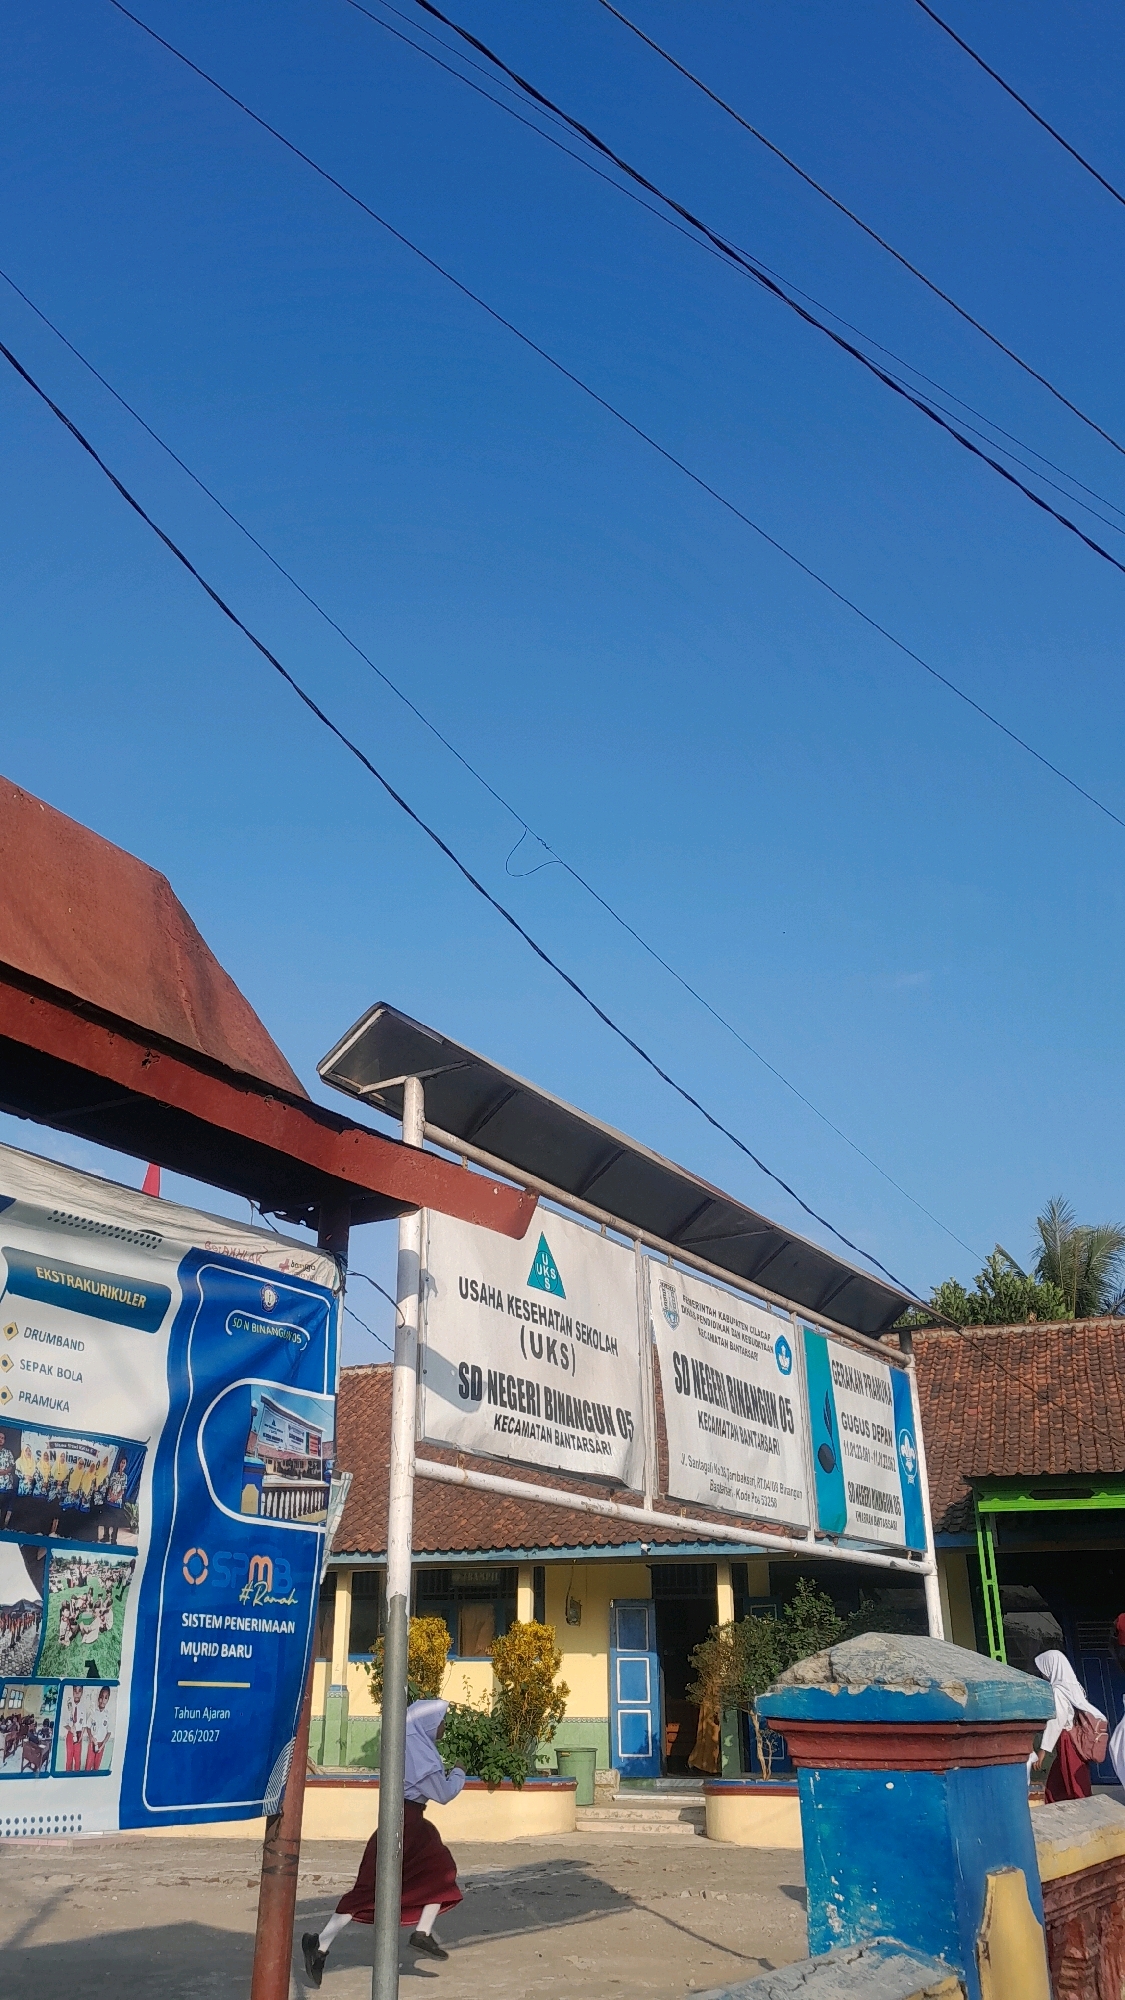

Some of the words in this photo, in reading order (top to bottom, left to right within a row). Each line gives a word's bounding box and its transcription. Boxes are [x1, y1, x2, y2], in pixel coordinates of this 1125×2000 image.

[35, 1266, 147, 1309] EKSTRAKURIKULER
[459, 1275, 504, 1312] USAHA
[507, 1293, 573, 1339] KESEHATAN
[575, 1320, 619, 1358] SEKOLAH
[680, 1304, 697, 1321] DINAS
[696, 1312, 730, 1335] PENDIDIKAN
[731, 1328, 741, 1340] DAN
[741, 1332, 774, 1354] KEBUDAYAAN
[682, 1294, 717, 1317] PEMERINTAH
[718, 1311, 749, 1333] KABUPATEN
[749, 1324, 771, 1341] CILACAP
[24, 1326, 85, 1351] DRUMBAND
[520, 1324, 576, 1377] (UKS)
[697, 1326, 729, 1348] KECAMATAN
[729, 1340, 759, 1361] BANTARSARI
[19, 1358, 53, 1376] SEPAK
[56, 1366, 83, 1383] BOLA
[831, 1359, 864, 1396] GERAKAN
[862, 1371, 893, 1407] PRAMUKA
[18, 1390, 70, 1412] PRAMUKA
[458, 1361, 483, 1402] SD
[487, 1368, 541, 1418] NEGERI
[544, 1385, 616, 1437] BINANGUN
[615, 1407, 635, 1442] 05
[672, 1350, 691, 1397] SD
[690, 1357, 730, 1412] NEGERI
[725, 1374, 780, 1431] BINANGUN
[778, 1394, 795, 1435] 05
[493, 1413, 552, 1445] KECAMATAN
[554, 1430, 612, 1456] BANTARSARI
[697, 1409, 740, 1442] KECAMATAN
[739, 1425, 781, 1456] BANTARSARI
[841, 1411, 871, 1439] GUGUS
[871, 1422, 894, 1448] DEPAN
[847, 1480, 856, 1504] SD
[855, 1483, 872, 1509] NEGERI
[182, 1612, 223, 1629] SISTEM
[224, 1615, 296, 1634] PENERIMAAN
[180, 1641, 219, 1659] MURID
[221, 1643, 253, 1659] BARU
[174, 1706, 201, 1719] Tahun
[202, 1706, 231, 1723] Ajaran
[170, 1729, 220, 1745] 2026/2027
